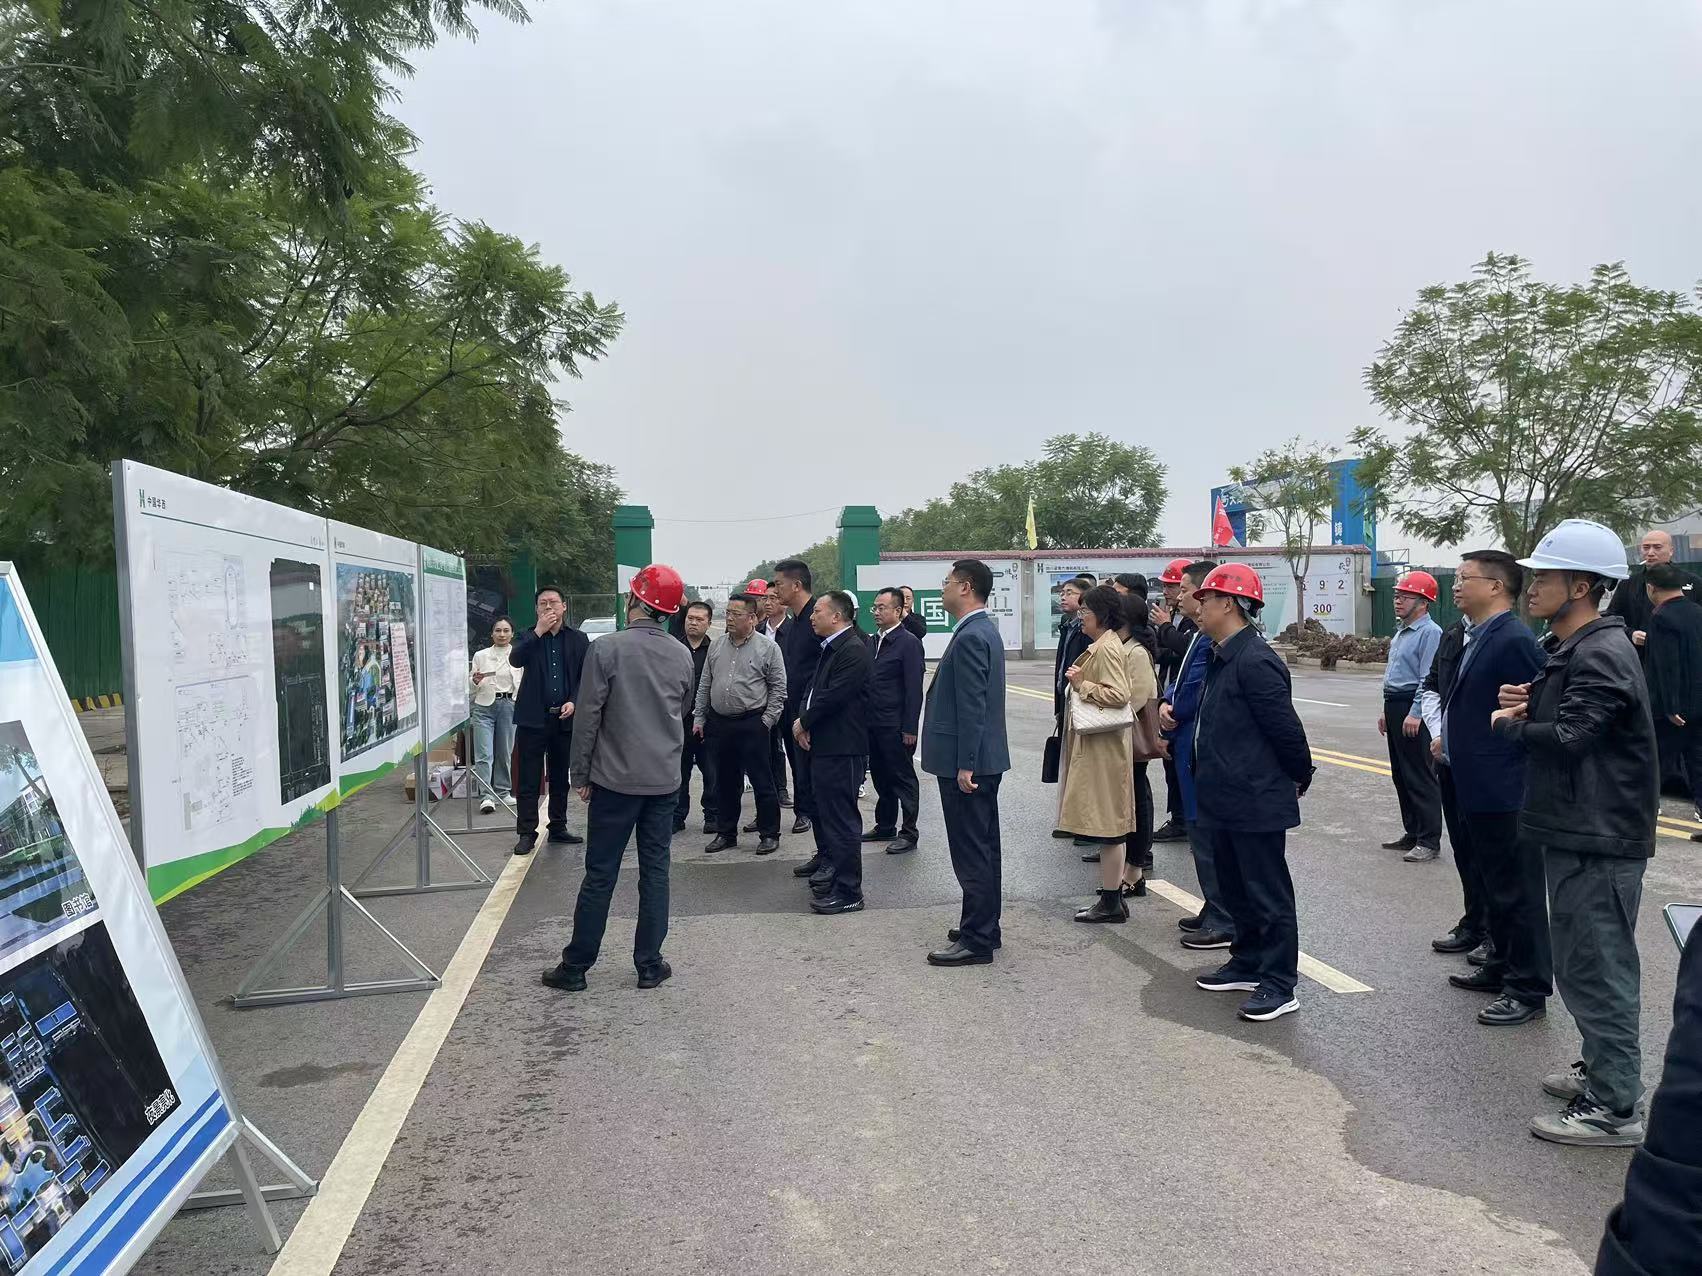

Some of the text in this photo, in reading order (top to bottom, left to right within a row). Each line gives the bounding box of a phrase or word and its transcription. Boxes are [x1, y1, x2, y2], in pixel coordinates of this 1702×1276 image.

[1319, 579, 1326, 590] 9
[1337, 579, 1345, 590] 2
[920, 597, 949, 626] 国
[1313, 603, 1332, 614] 300
[61, 893, 93, 919] 图书馆
[145, 1089, 175, 1125] 夜景亮化
